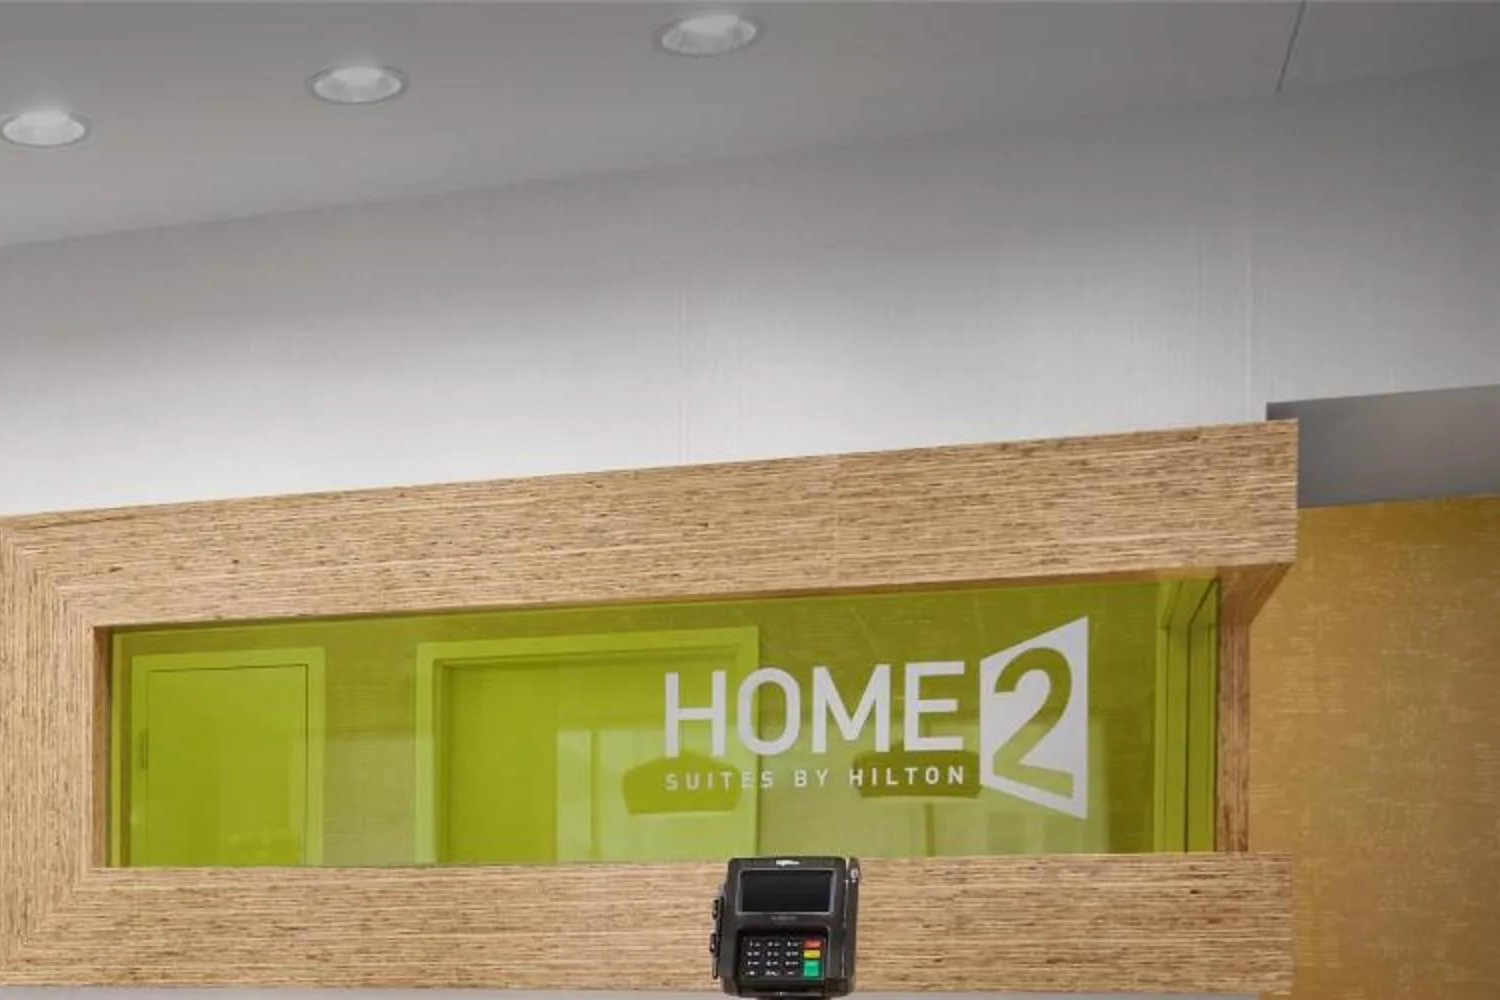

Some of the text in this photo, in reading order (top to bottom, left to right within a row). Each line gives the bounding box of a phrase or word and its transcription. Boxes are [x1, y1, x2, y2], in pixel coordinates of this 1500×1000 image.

[664, 646, 1074, 800] HOME 2
[665, 764, 965, 791] SUITES BY HILTON
